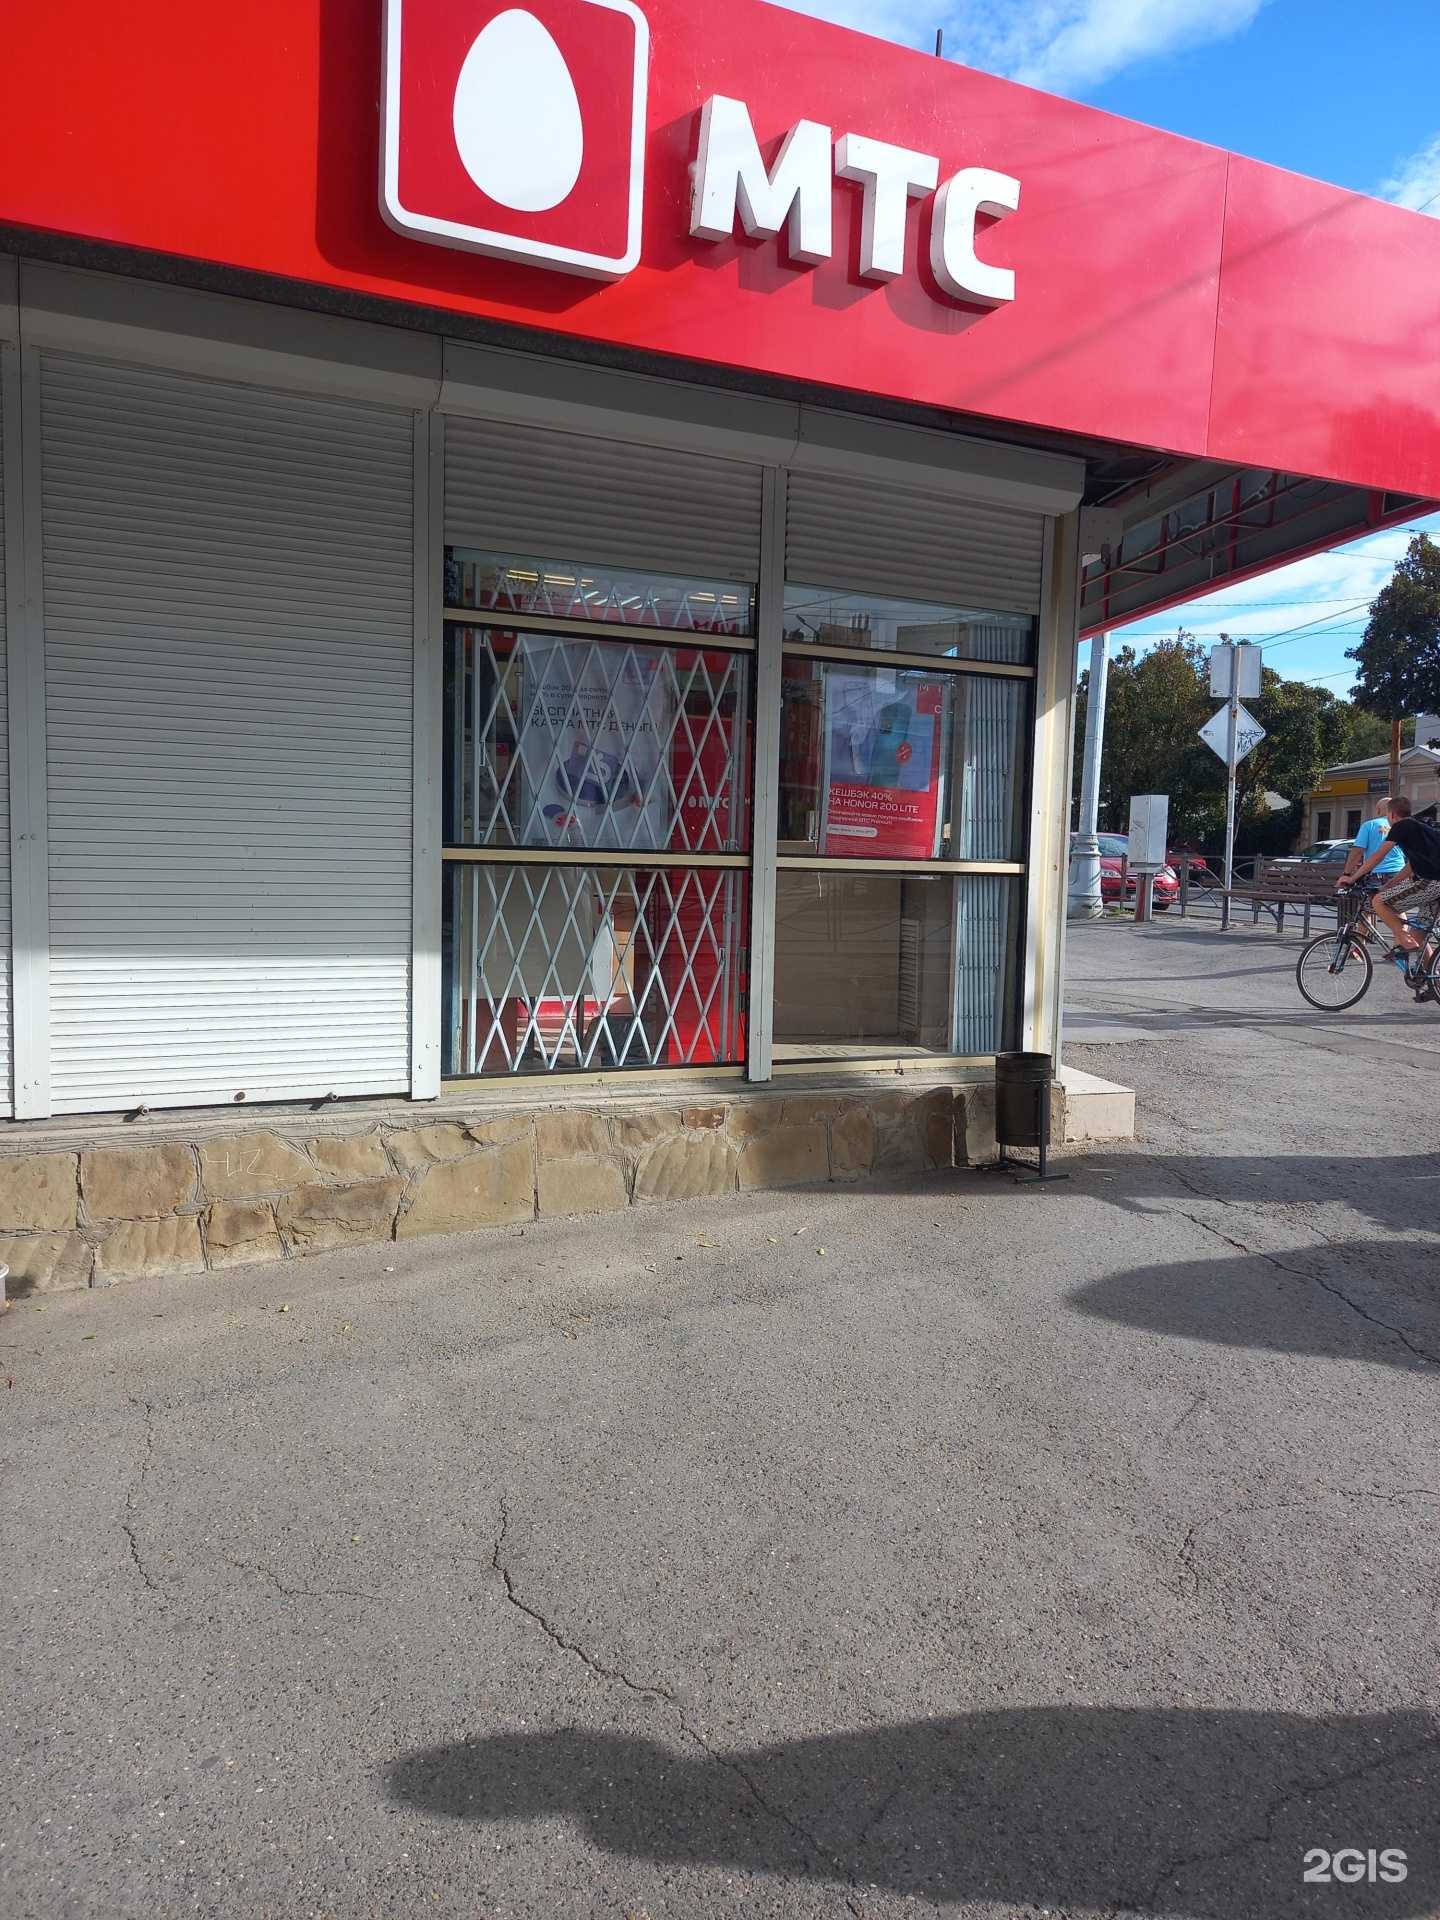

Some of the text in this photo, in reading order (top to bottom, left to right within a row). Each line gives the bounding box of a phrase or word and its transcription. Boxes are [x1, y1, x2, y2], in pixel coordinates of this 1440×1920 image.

[690, 94, 1021, 303] МТС
[531, 718, 576, 730] КАРТА
[871, 791, 894, 802] 40%
[843, 798, 878, 810] HONOR
[879, 801, 899, 812] 200
[899, 804, 921, 815] LITE
